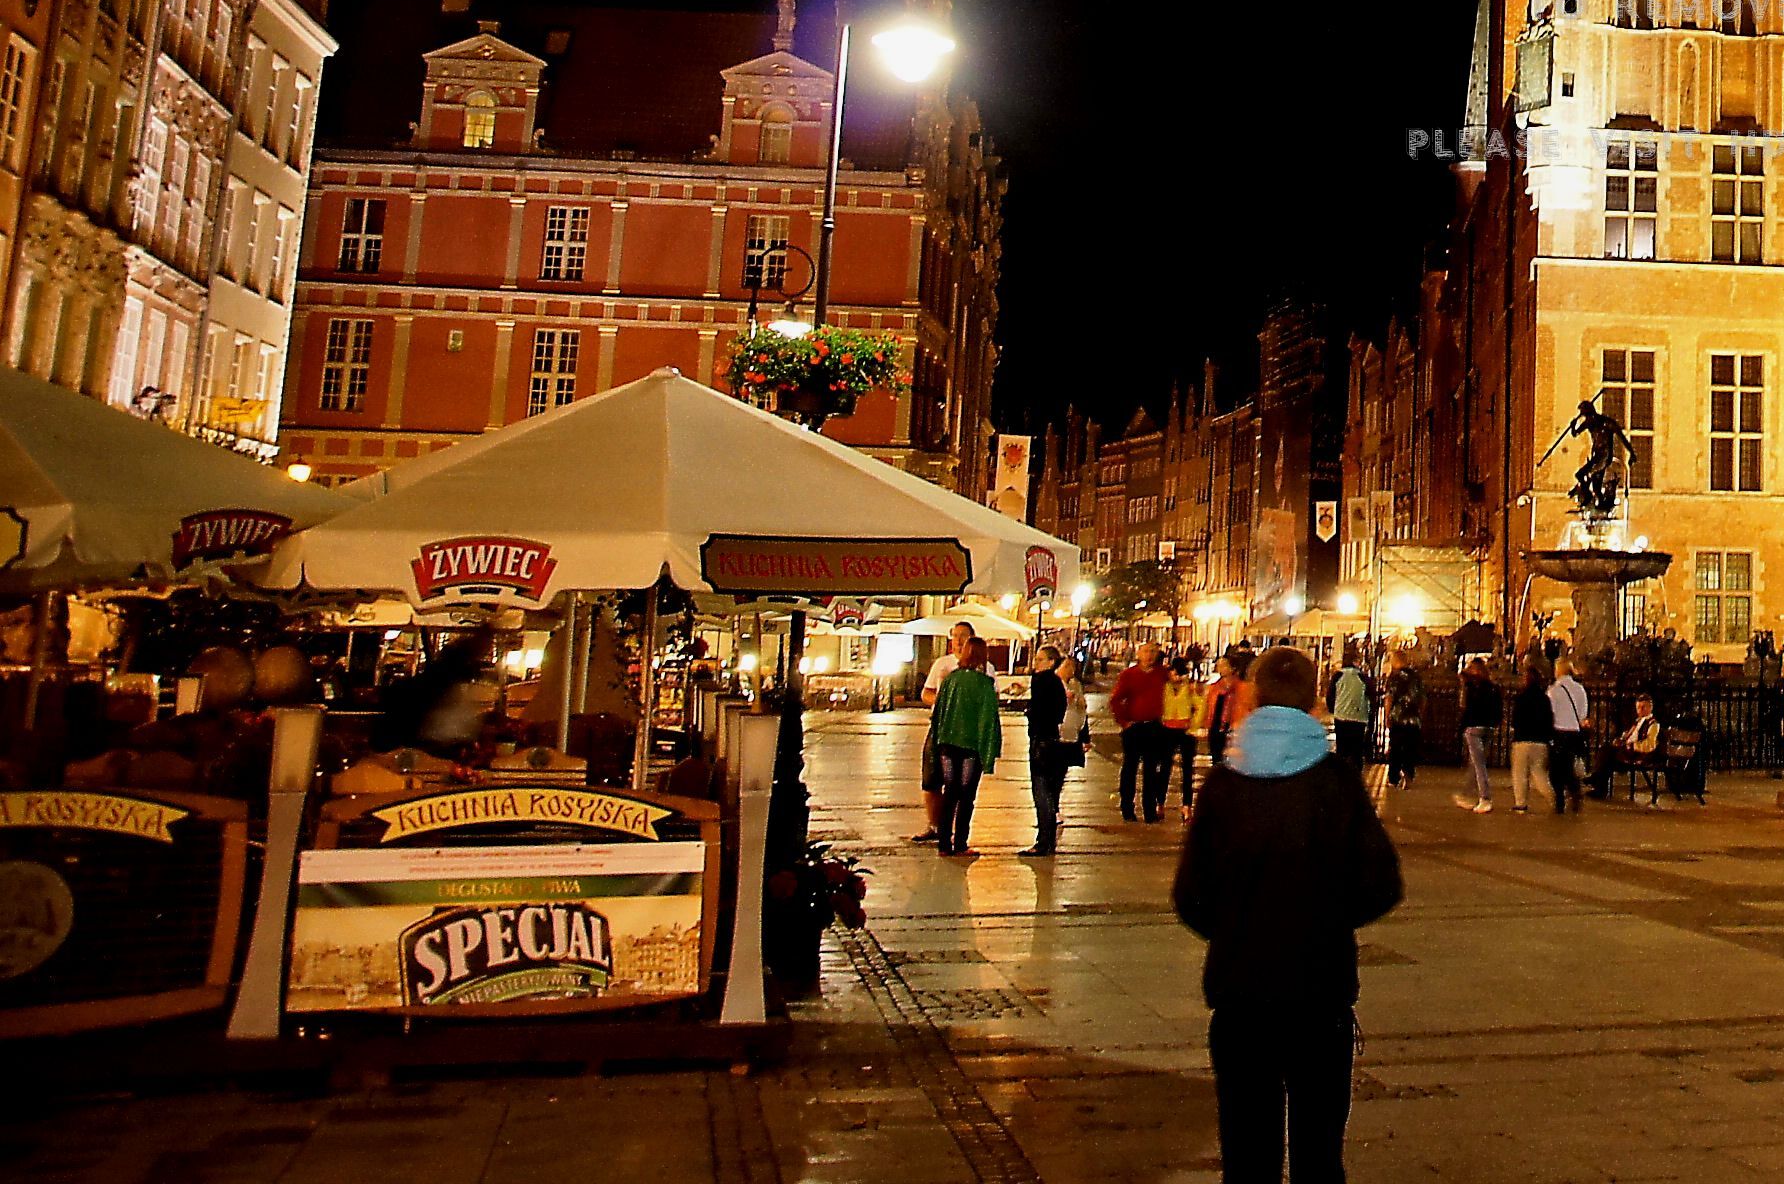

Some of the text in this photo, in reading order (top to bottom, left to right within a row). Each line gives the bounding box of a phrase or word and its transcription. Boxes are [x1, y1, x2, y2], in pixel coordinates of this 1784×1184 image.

[432, 545, 541, 580] ŻYWIEC
[718, 551, 834, 580] KUCHNIA
[397, 793, 519, 832] KUCHNIA
[413, 906, 610, 999] SPECJAL
